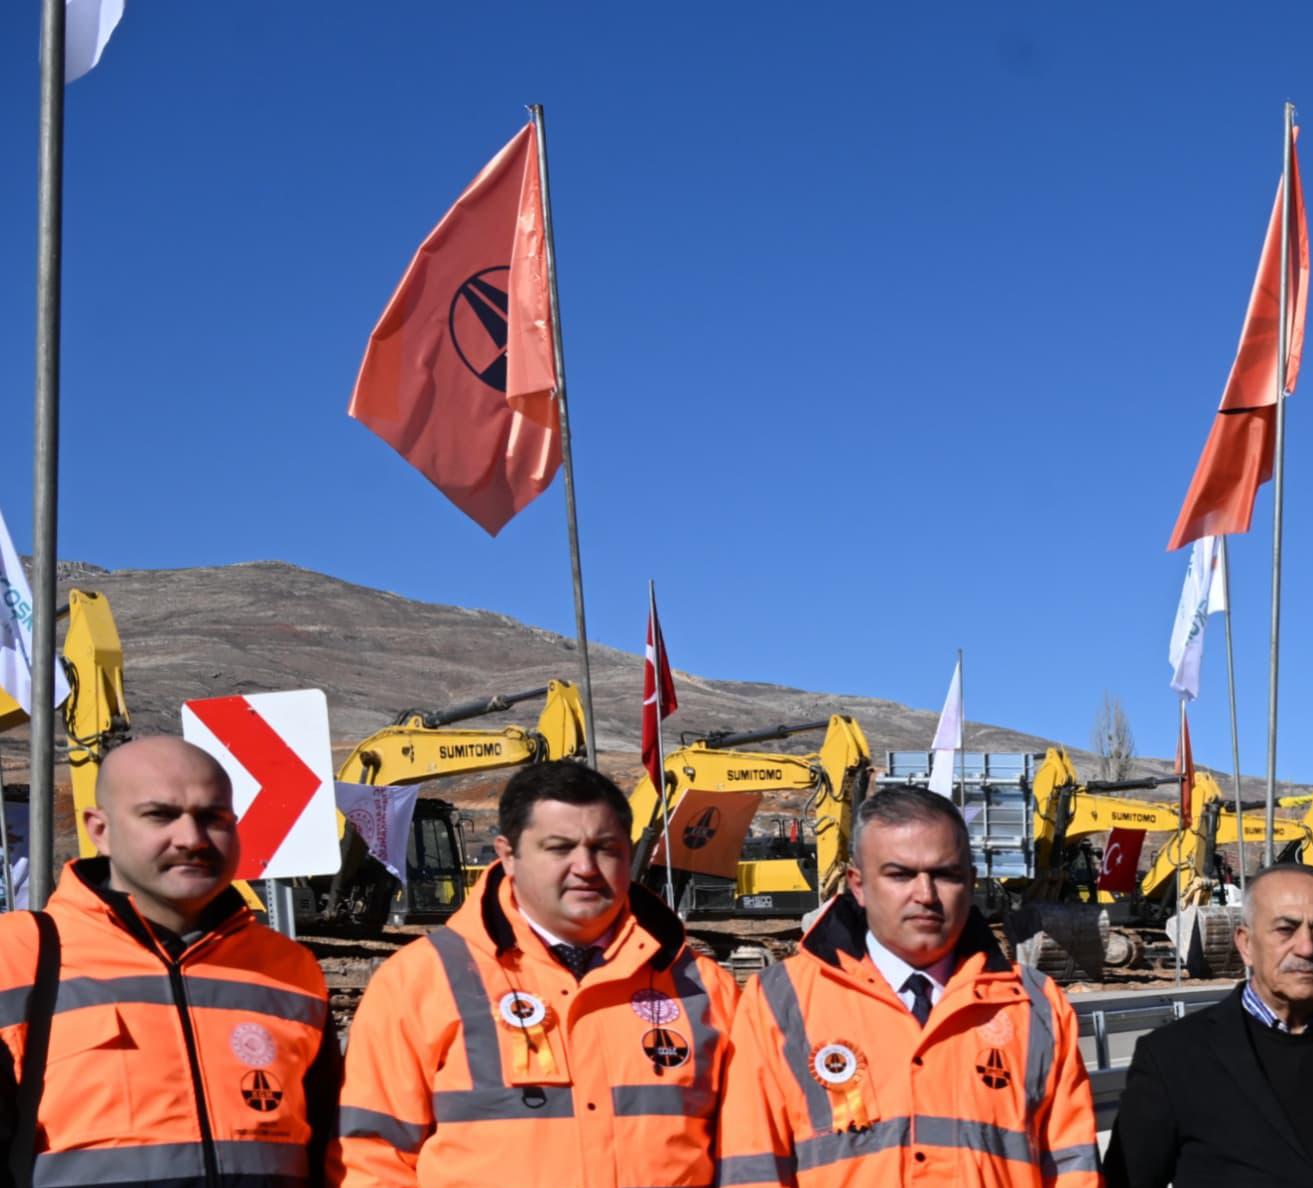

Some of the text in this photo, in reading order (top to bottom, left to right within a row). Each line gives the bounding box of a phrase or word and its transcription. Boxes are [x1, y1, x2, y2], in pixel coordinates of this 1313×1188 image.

[439, 743, 502, 759] SUMITOMO
[727, 769, 783, 781] SUMITOMO
[1111, 811, 1157, 824] SUMITOMO
